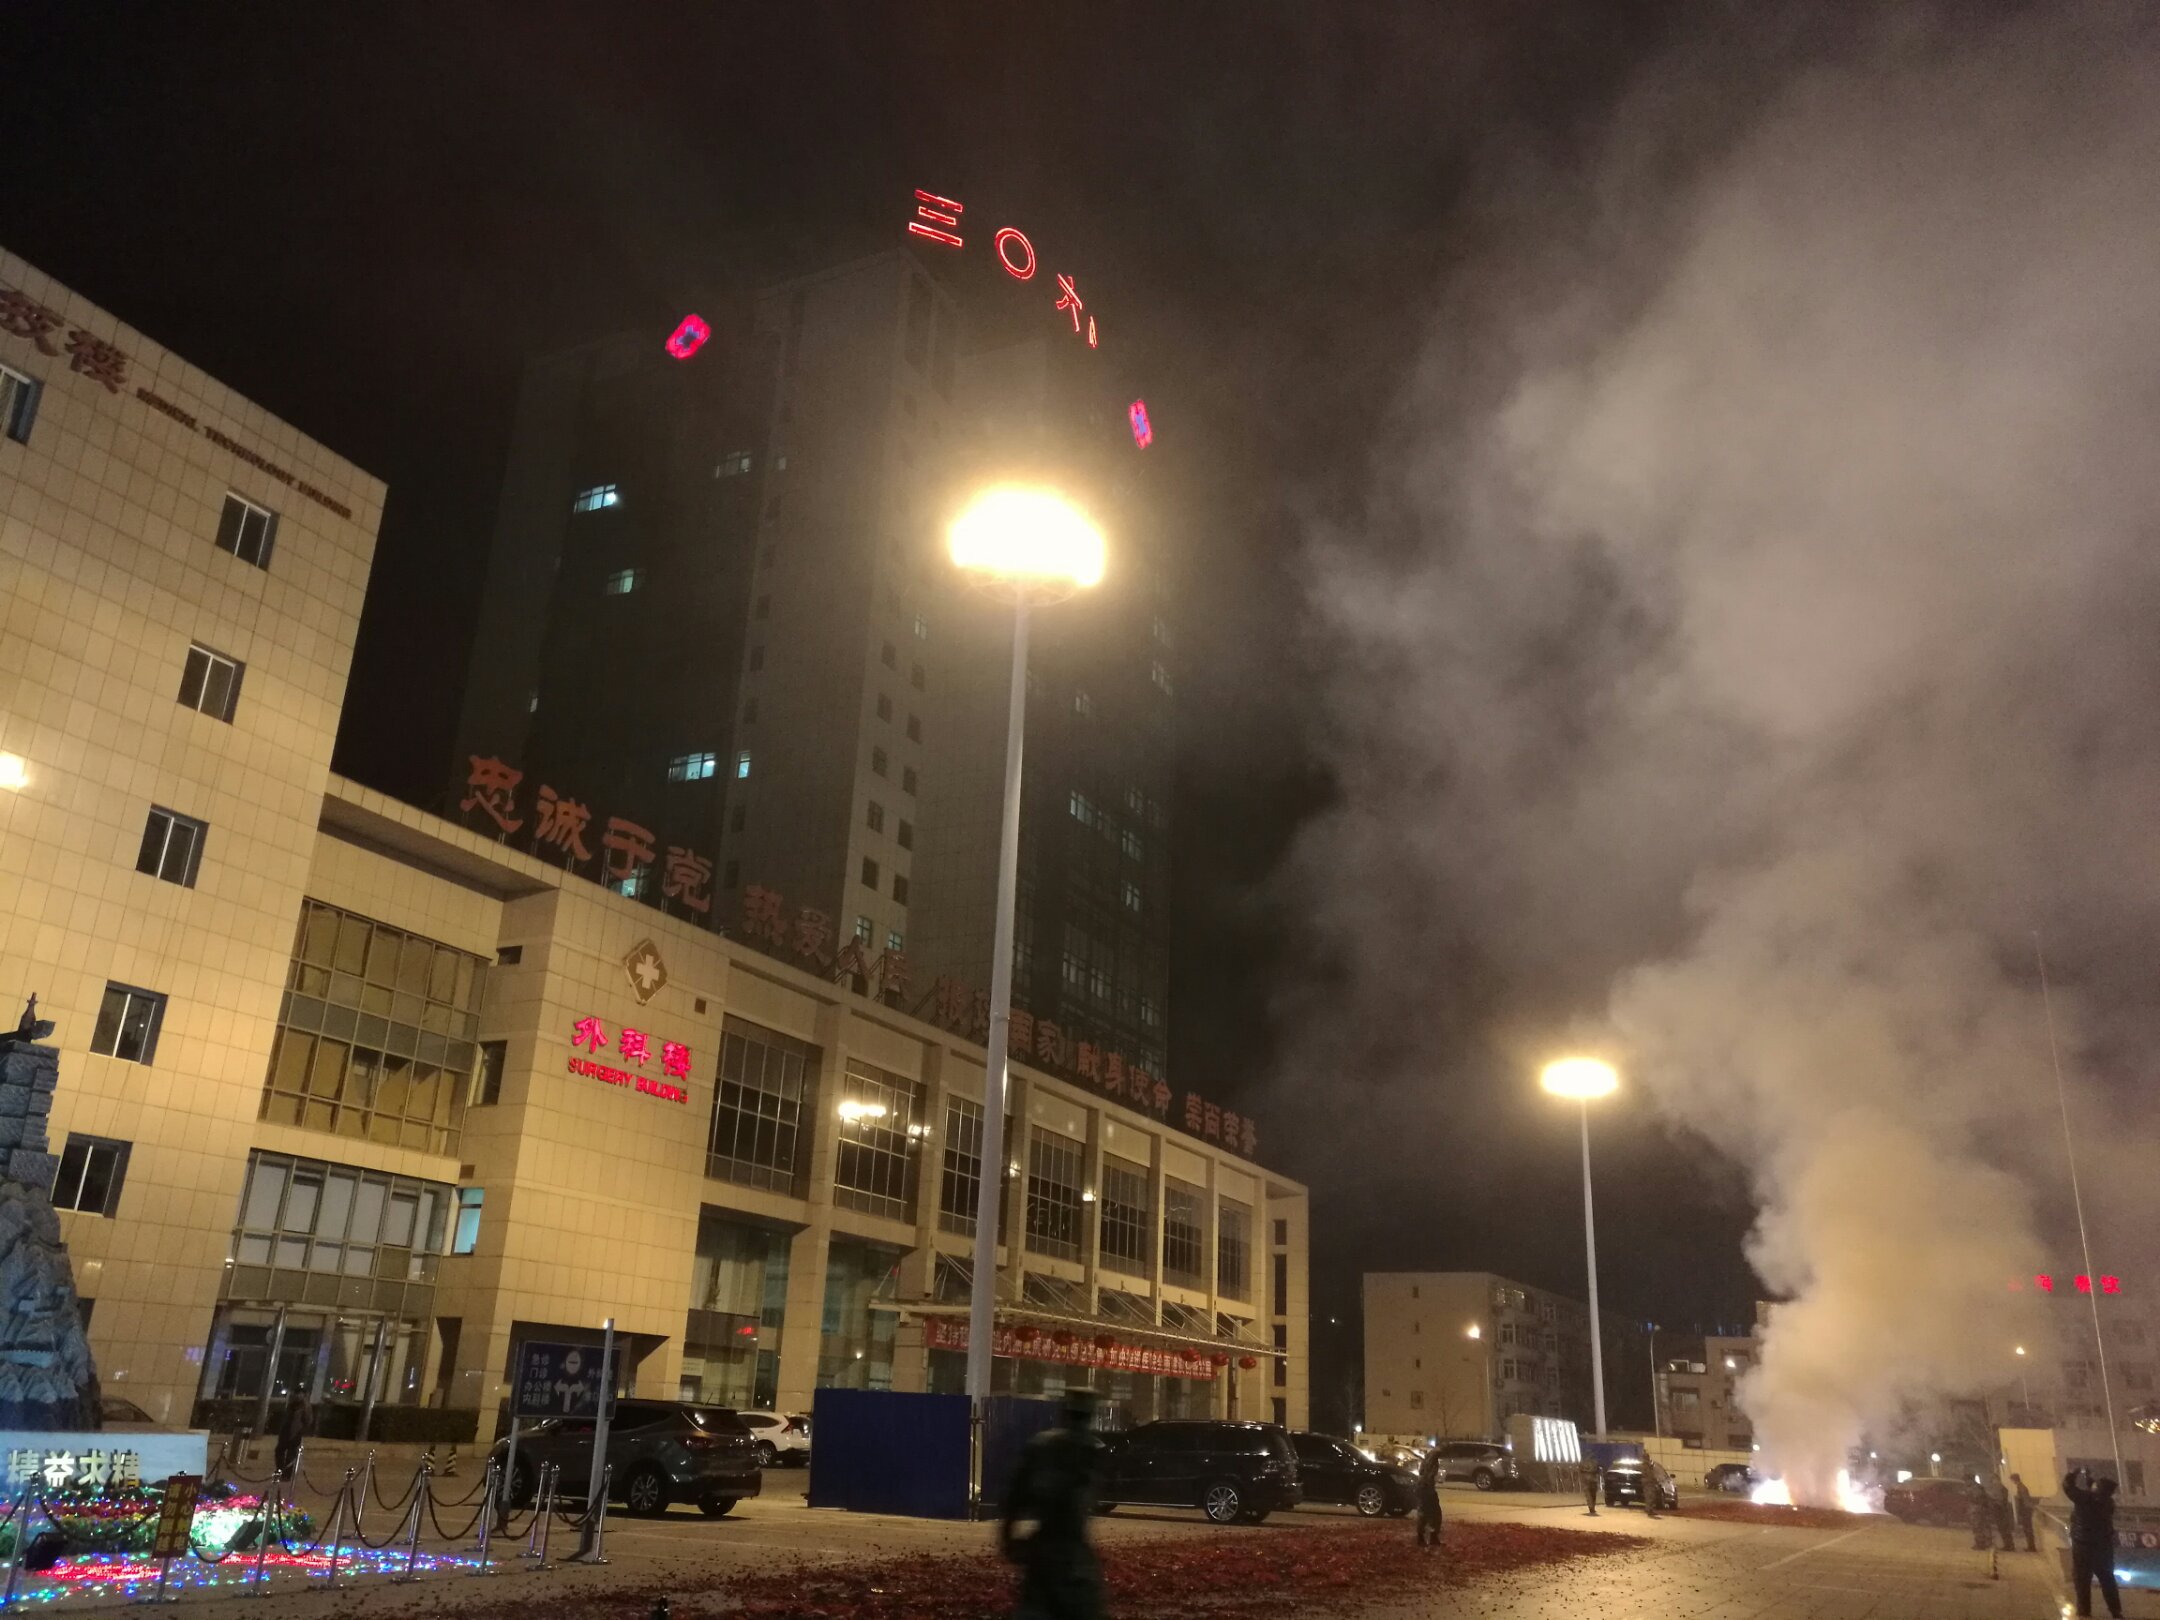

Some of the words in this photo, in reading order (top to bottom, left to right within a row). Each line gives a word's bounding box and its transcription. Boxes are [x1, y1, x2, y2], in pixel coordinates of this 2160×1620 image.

[459, 753, 713, 914] 忠诚于党
[571, 1015, 692, 1081] 外科楼
[568, 1056, 634, 1088] SURGERY
[635, 1075, 689, 1105] BUILDING
[7, 1448, 141, 1488] 精益求精
